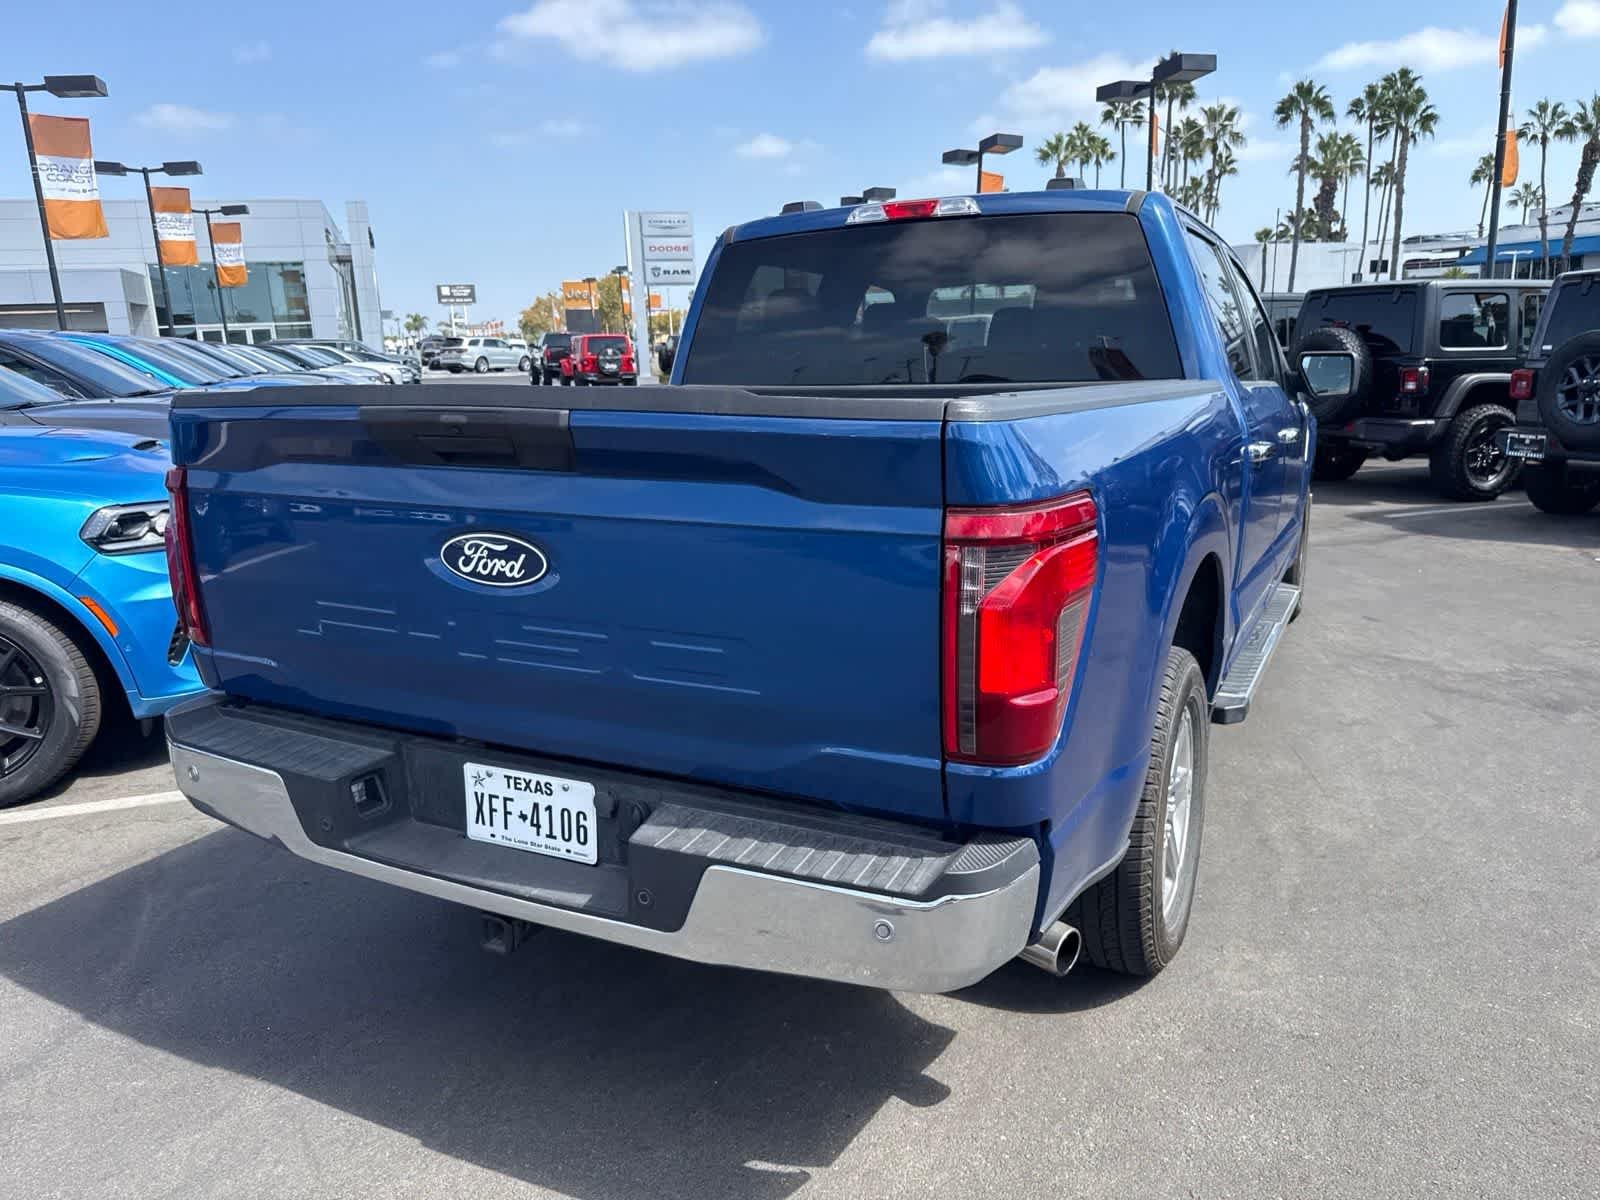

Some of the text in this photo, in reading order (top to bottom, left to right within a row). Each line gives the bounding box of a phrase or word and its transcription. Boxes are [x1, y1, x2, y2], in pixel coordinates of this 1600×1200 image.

[648, 245, 689, 253] DODGE
[459, 540, 526, 578] Ford
[504, 774, 554, 797] TEXAS
[474, 791, 588, 846] XFF 4106
[501, 834, 512, 843] The
[530, 841, 543, 849] Star
